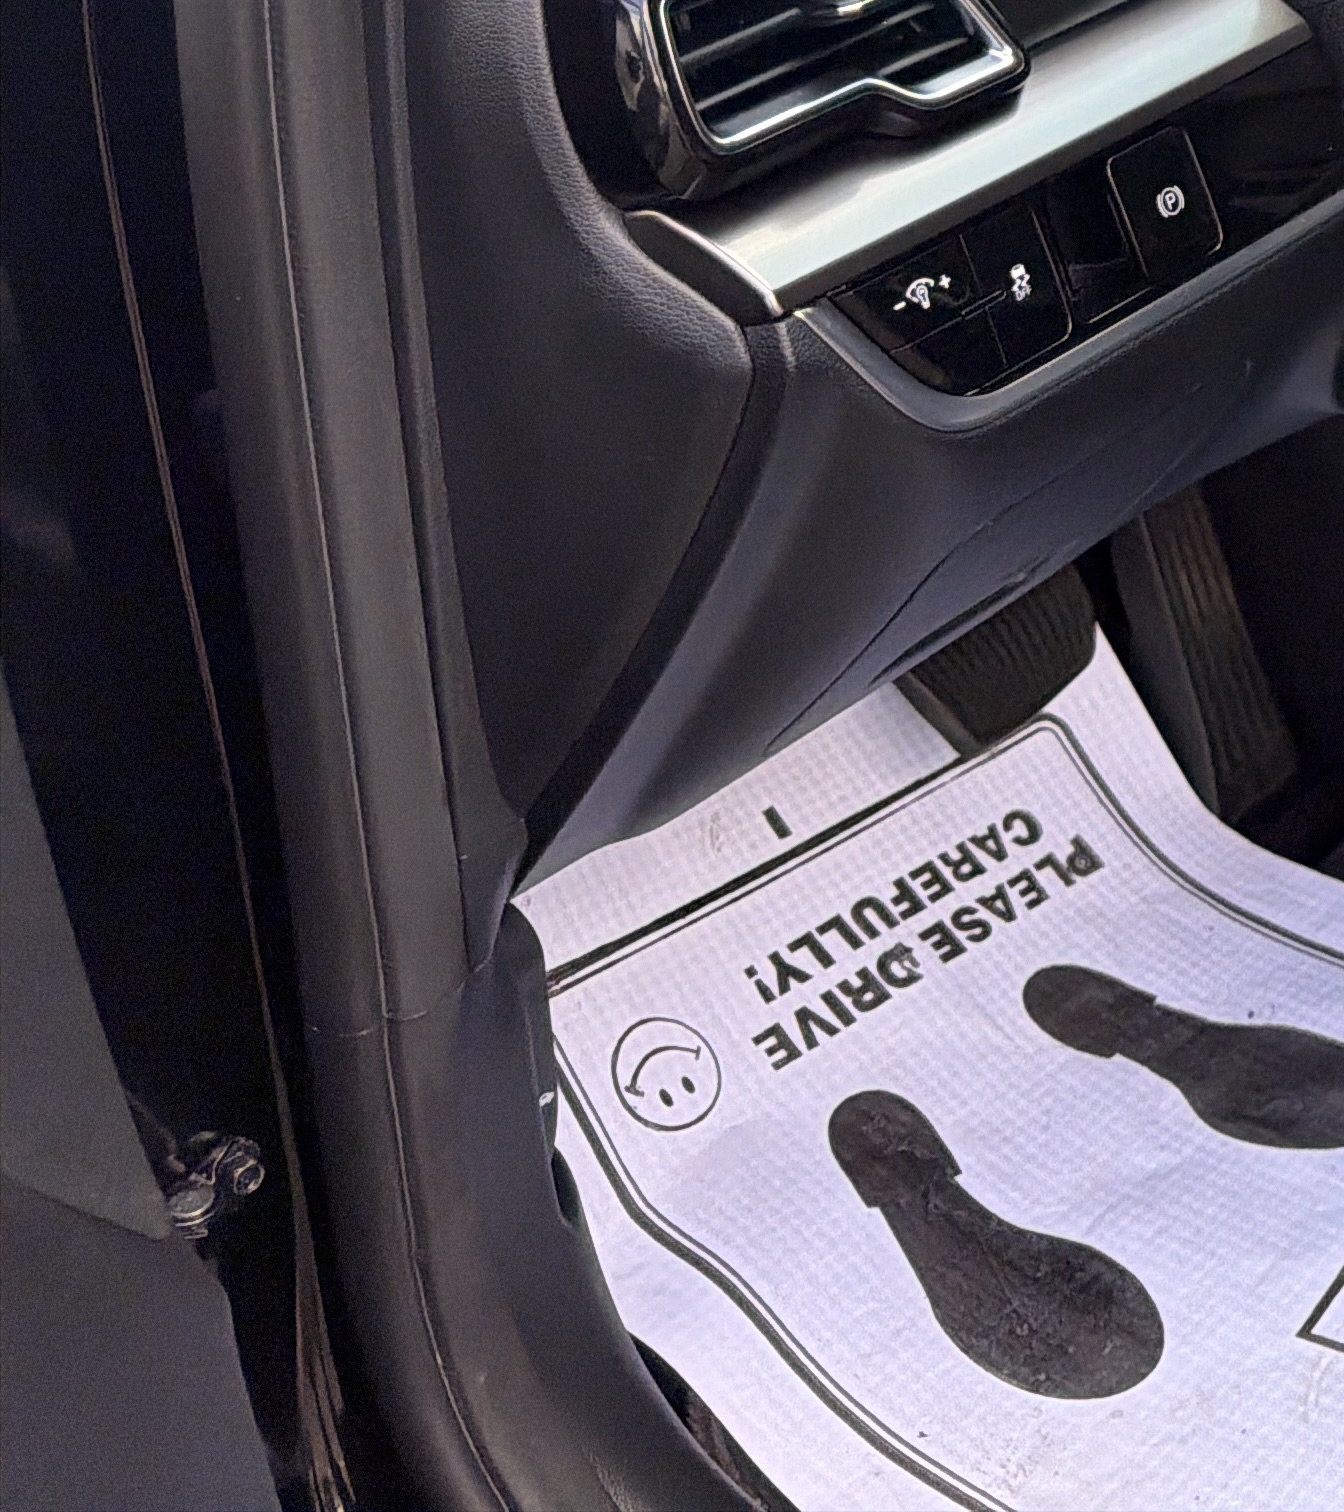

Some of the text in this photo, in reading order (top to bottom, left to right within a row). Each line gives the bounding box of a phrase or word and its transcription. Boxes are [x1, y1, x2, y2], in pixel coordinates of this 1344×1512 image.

[1014, 287, 1033, 302] OFF
[743, 808, 1044, 1005] CAREFULLY!
[751, 835, 1106, 1072] PLEASE DRIVE
